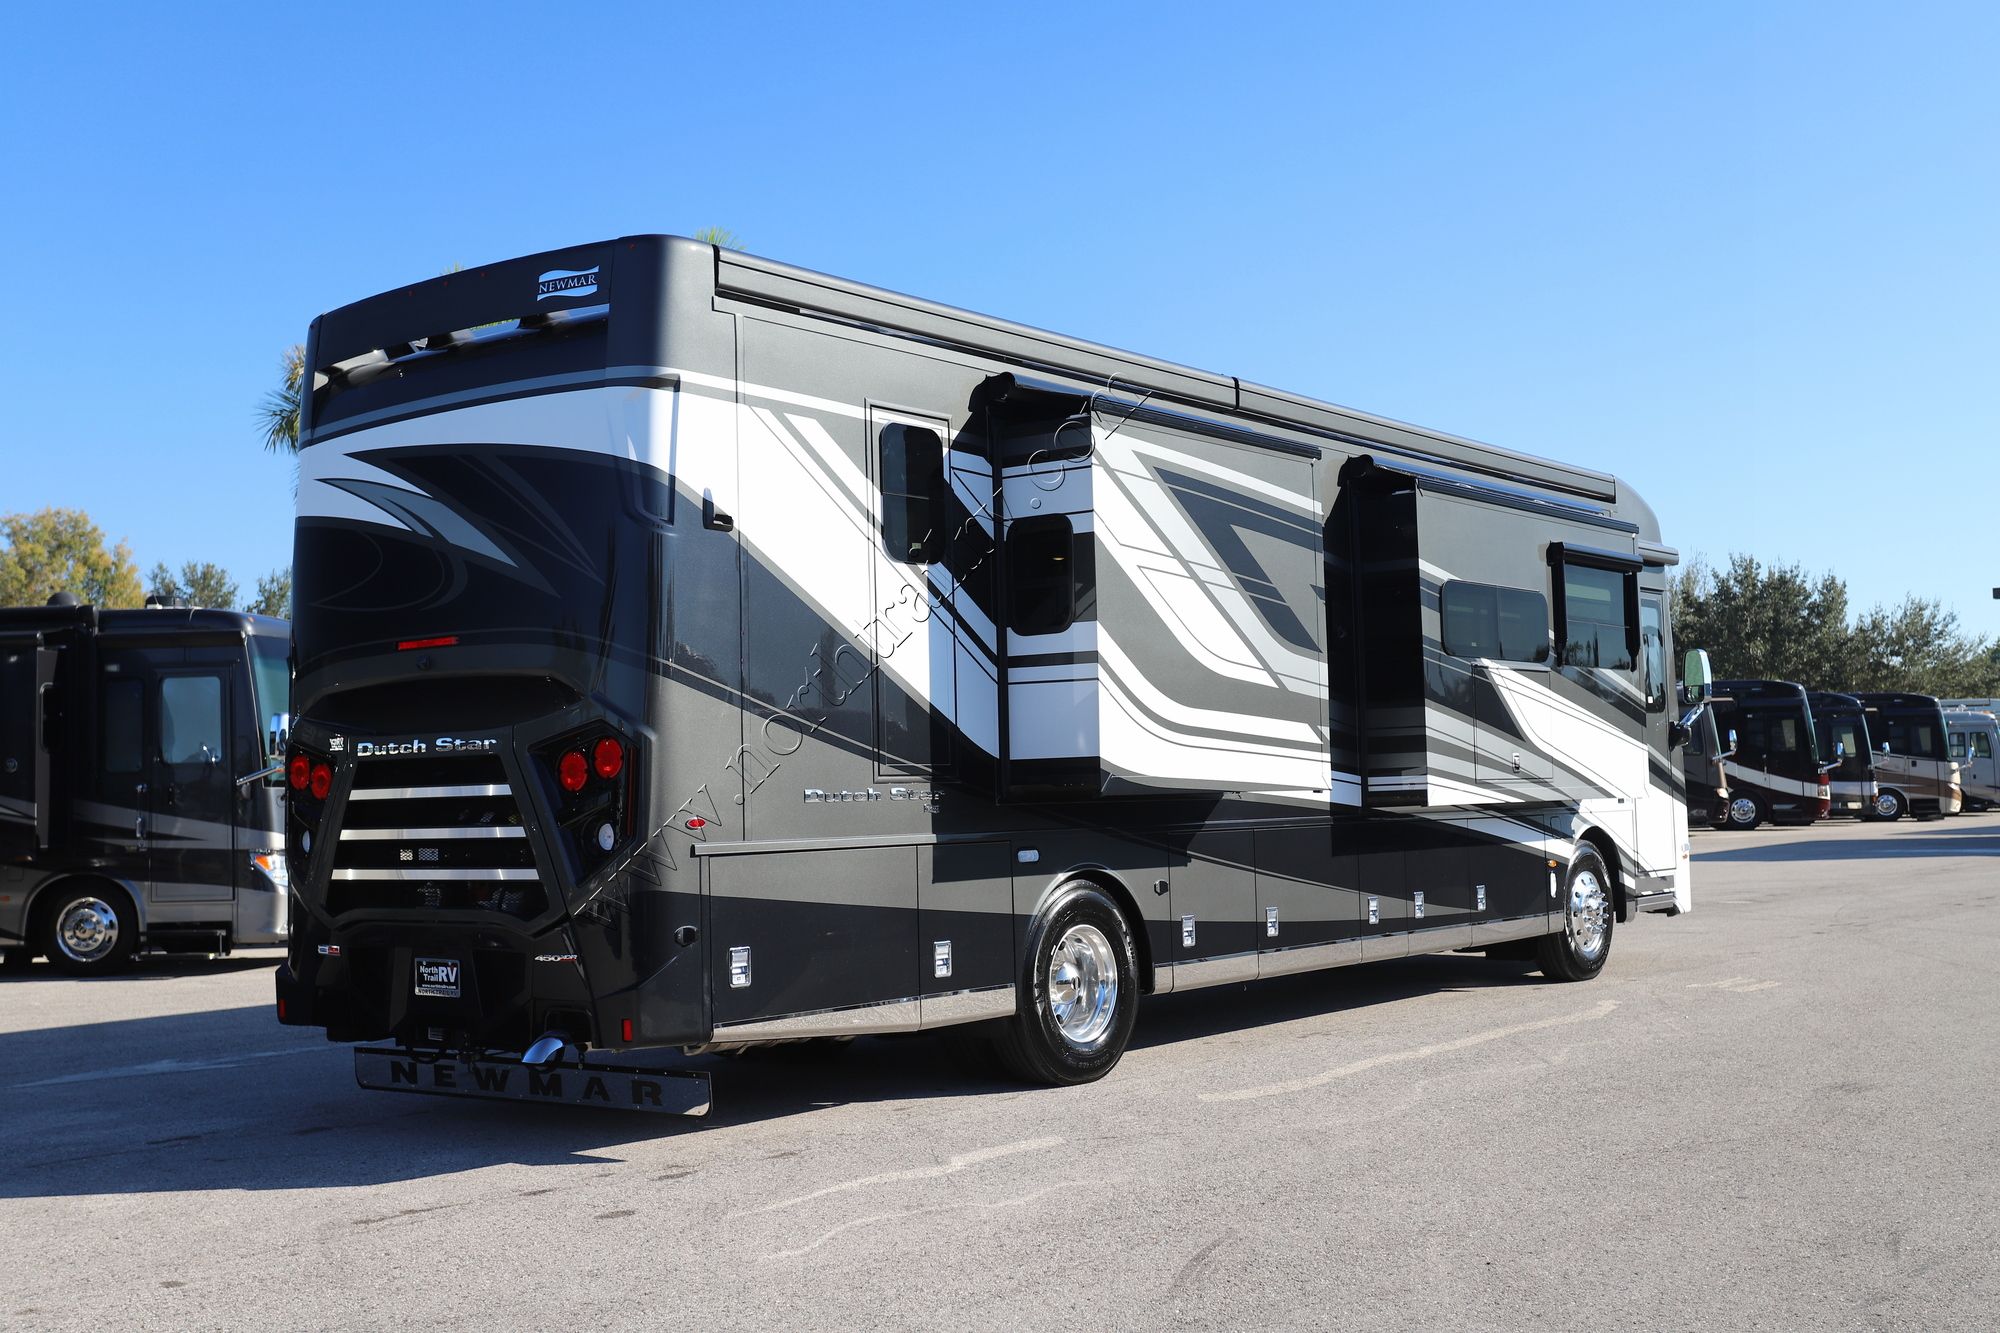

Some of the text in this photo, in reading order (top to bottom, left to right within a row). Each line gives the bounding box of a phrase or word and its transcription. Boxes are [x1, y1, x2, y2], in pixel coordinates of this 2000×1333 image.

[538, 274, 597, 294] NEWMAR
[357, 739, 427, 757] Dutch
[435, 737, 498, 752] Star
[804, 787, 945, 803] Dutch Star
[439, 966, 457, 982] RV
[390, 1060, 663, 1107] NEWMAR
